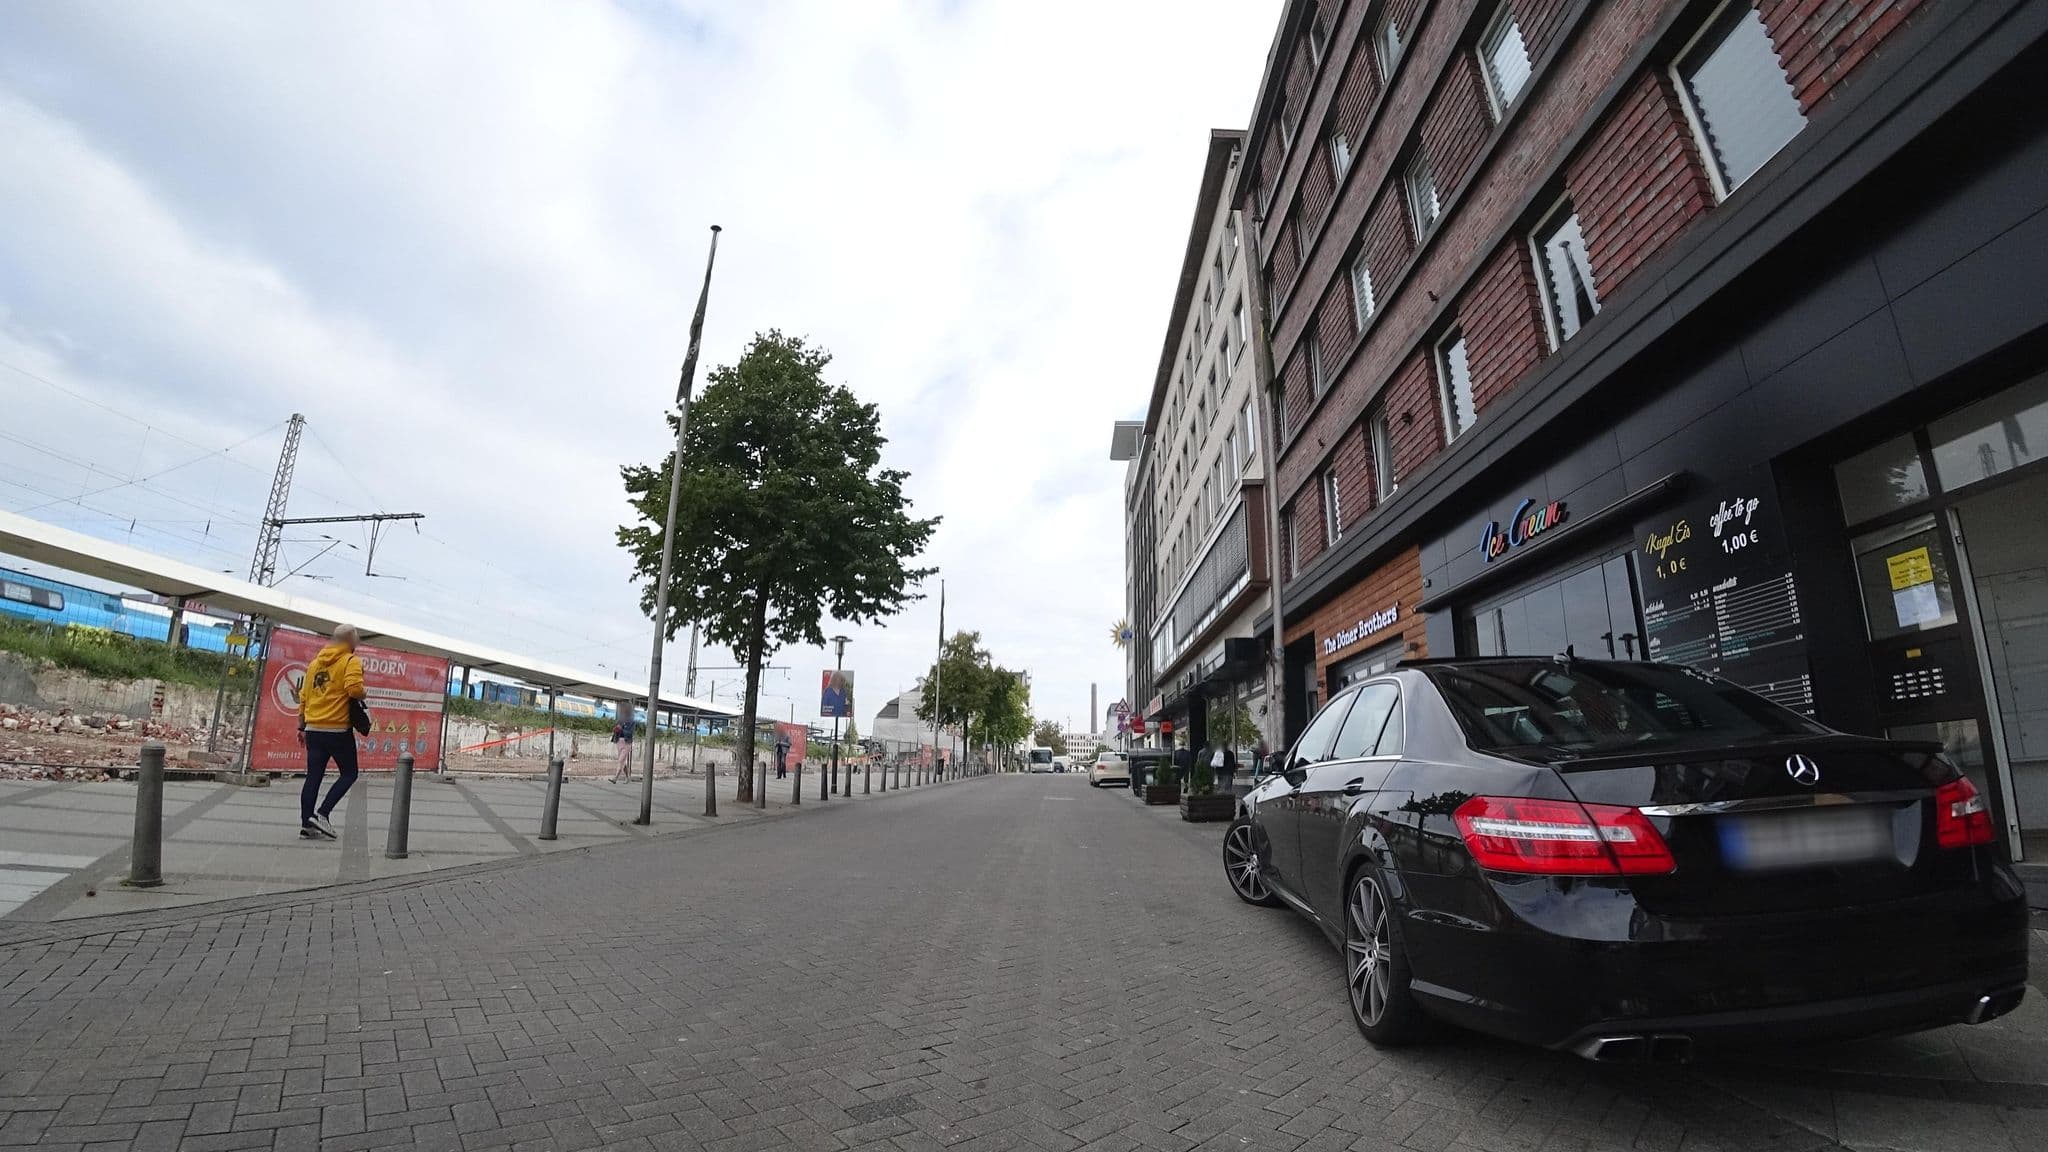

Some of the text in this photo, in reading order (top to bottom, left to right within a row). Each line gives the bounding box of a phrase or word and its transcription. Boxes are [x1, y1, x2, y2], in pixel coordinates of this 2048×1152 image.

[1480, 497, 1565, 562] Ice Cream
[1709, 497, 1760, 538] coffee to go
[1645, 520, 1691, 560] Kugel Eis
[1721, 529, 1759, 555] 1,00 €
[1323, 636, 1337, 655] The
[1336, 626, 1359, 650] Döner
[361, 656, 408, 676] EDORN
